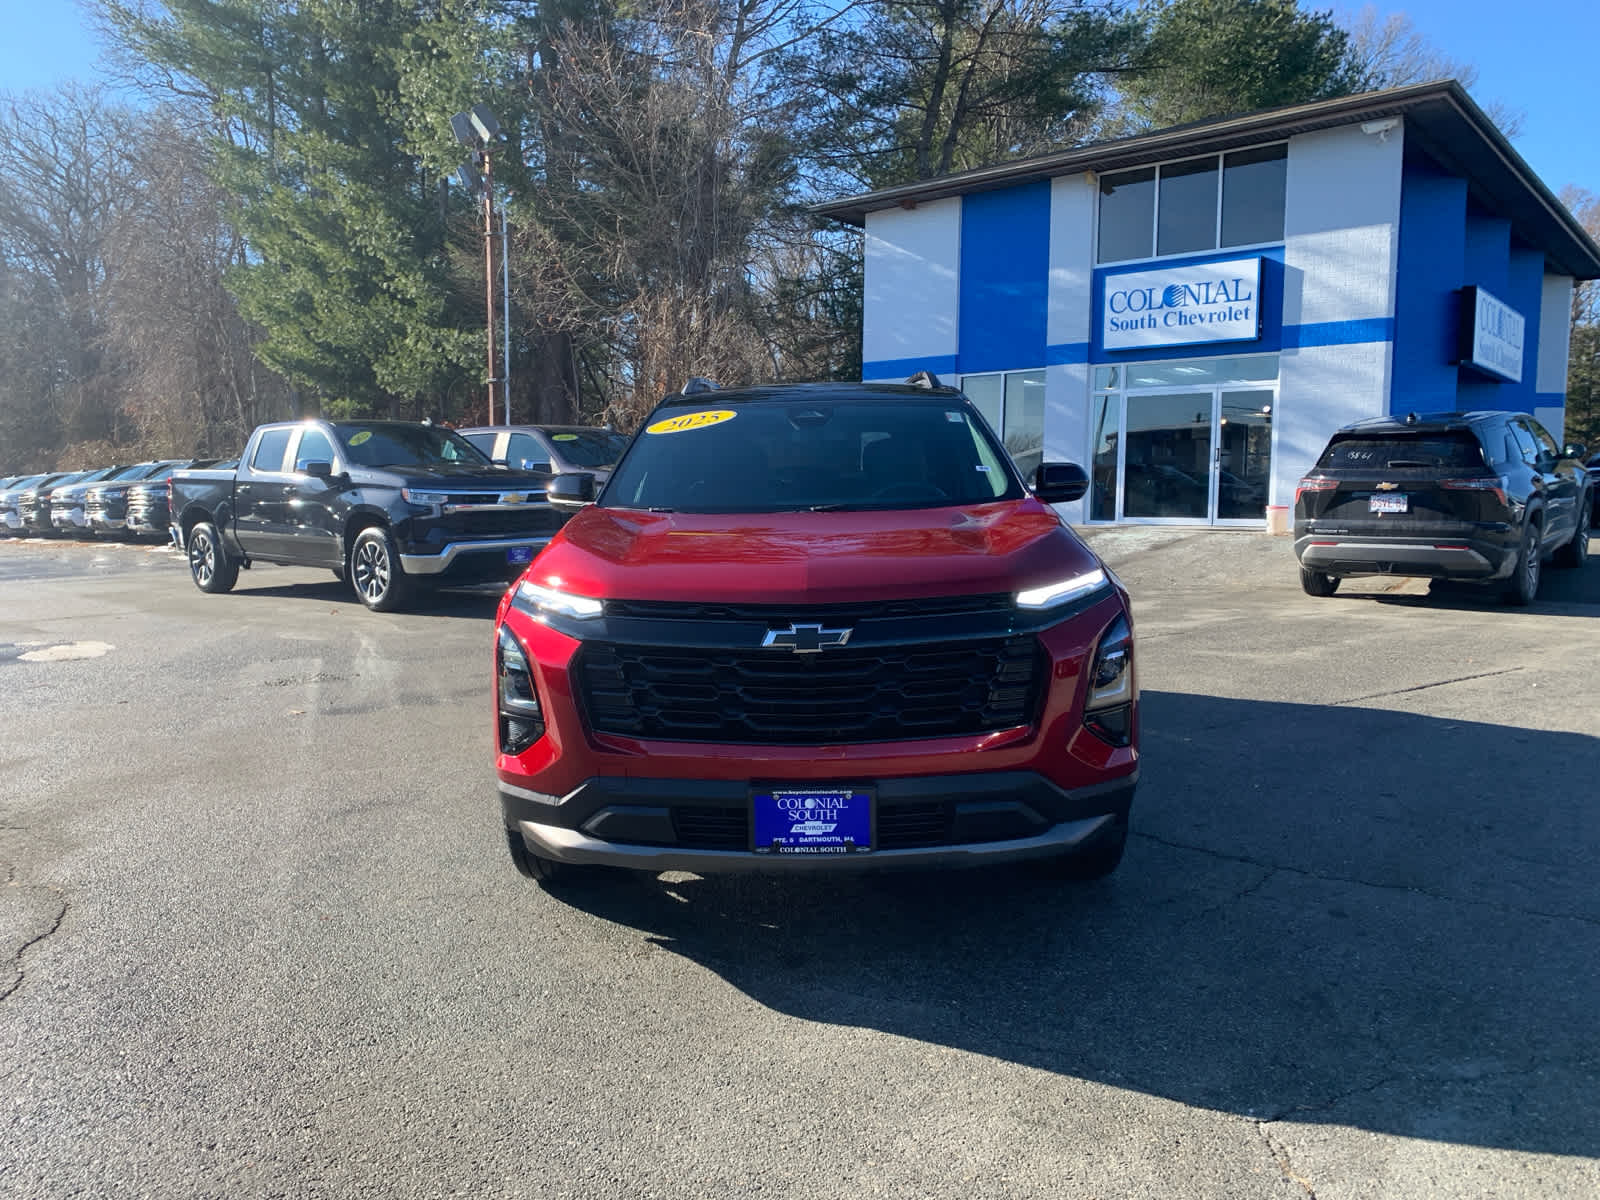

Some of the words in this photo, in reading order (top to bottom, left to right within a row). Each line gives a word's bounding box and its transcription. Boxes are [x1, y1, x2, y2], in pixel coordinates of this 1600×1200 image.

[1110, 278, 1252, 314] COLONIAL
[1110, 316, 1157, 332] South
[1163, 305, 1250, 328] Chevrolet
[664, 411, 720, 431] 2025
[777, 798, 849, 810] COLONIAL
[788, 809, 837, 821] SOUTH
